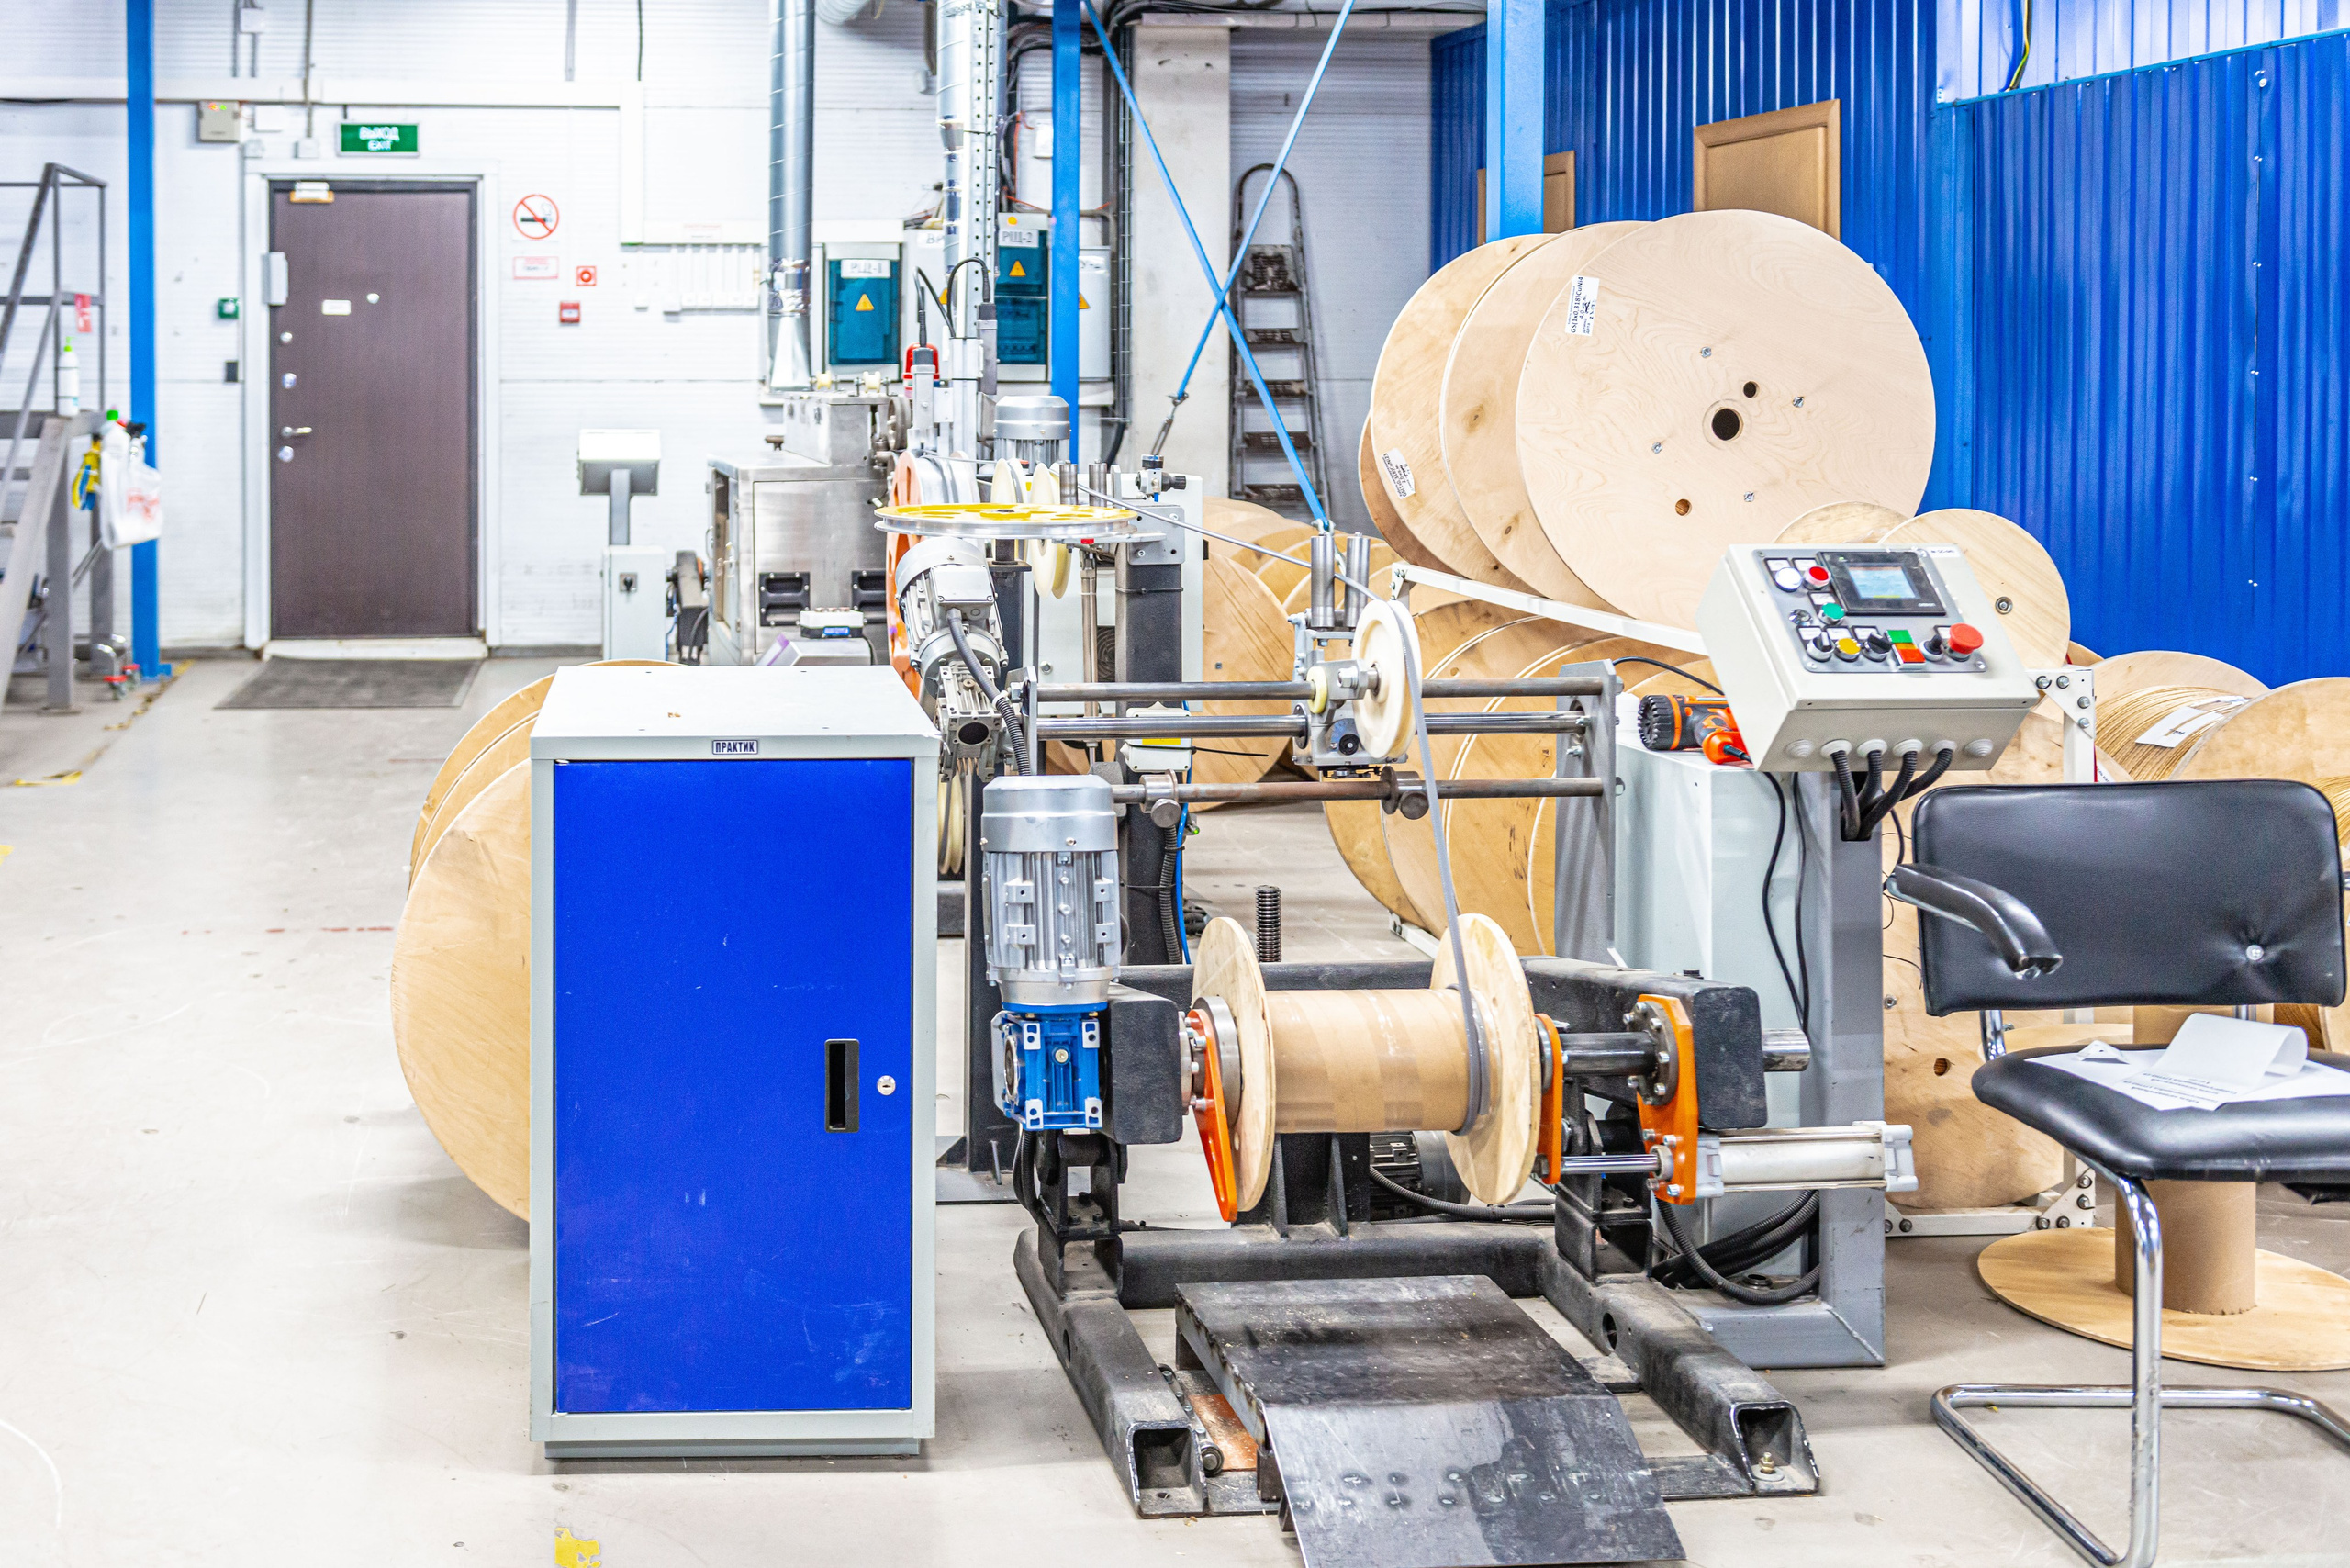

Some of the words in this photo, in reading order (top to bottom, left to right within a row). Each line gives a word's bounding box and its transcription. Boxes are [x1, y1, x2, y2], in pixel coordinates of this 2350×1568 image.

[359, 126, 400, 142] ВЫХОД
[367, 140, 393, 151] EXIT
[716, 742, 755, 753] ПРАКТИК
